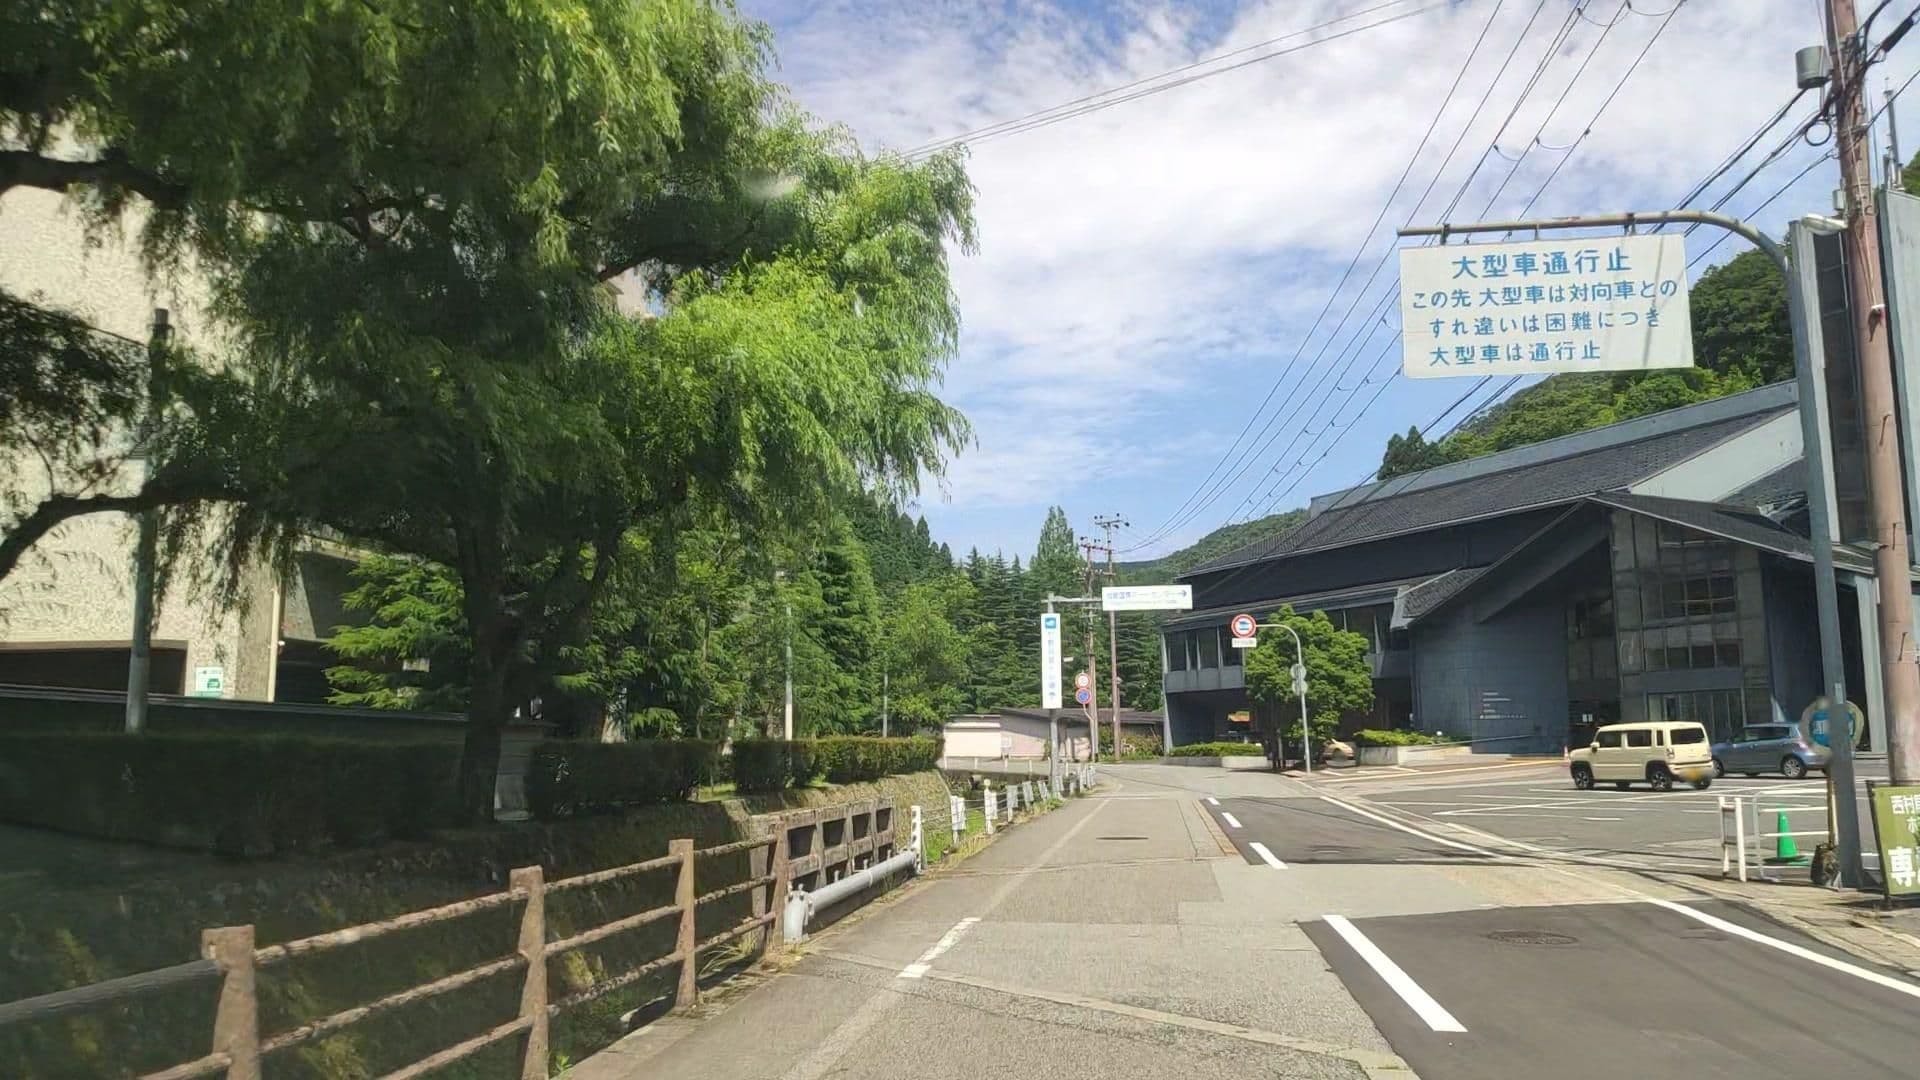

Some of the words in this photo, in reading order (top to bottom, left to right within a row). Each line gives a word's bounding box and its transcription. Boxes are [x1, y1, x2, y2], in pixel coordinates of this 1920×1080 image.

[1452, 247, 1632, 280] 大型車通行止
[1429, 309, 1661, 338] すれ違いは困難につき
[1430, 340, 1601, 366] 大型車は通行止
